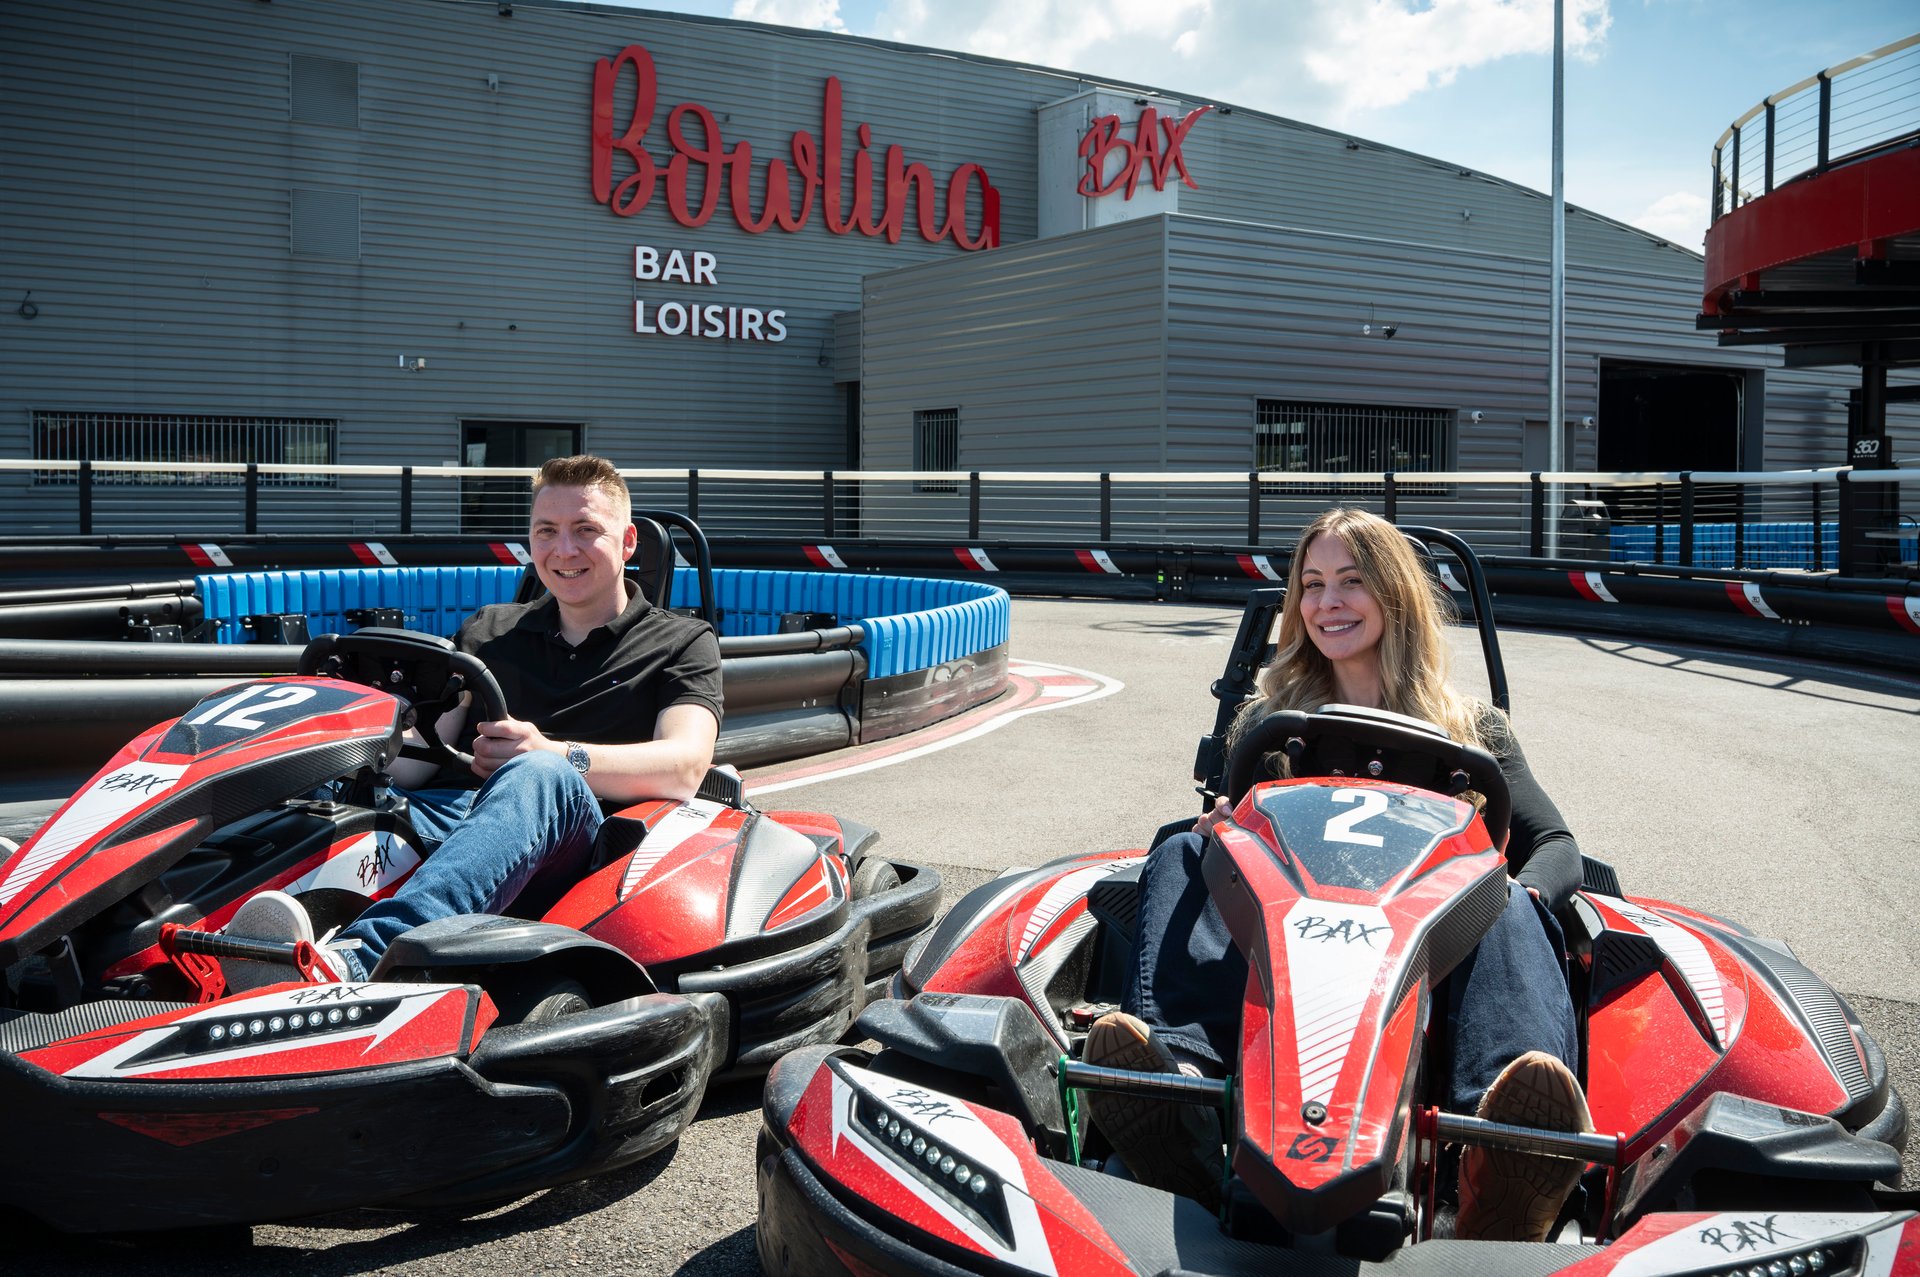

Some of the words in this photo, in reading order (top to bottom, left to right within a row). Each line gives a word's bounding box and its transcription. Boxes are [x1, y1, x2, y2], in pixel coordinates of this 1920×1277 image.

[1077, 105, 1215, 201] BAX
[635, 245, 718, 285] BAR
[635, 300, 787, 342] LOISIRS
[1854, 440, 1880, 454] 360
[188, 684, 317, 730] 12
[98, 773, 180, 795] BAX
[1323, 788, 1389, 848] 2
[357, 833, 396, 888] BAX
[1294, 916, 1392, 951] BAX
[289, 984, 376, 1005] BAX
[886, 1089, 976, 1125] BAX
[1699, 1214, 1807, 1253] BAX
